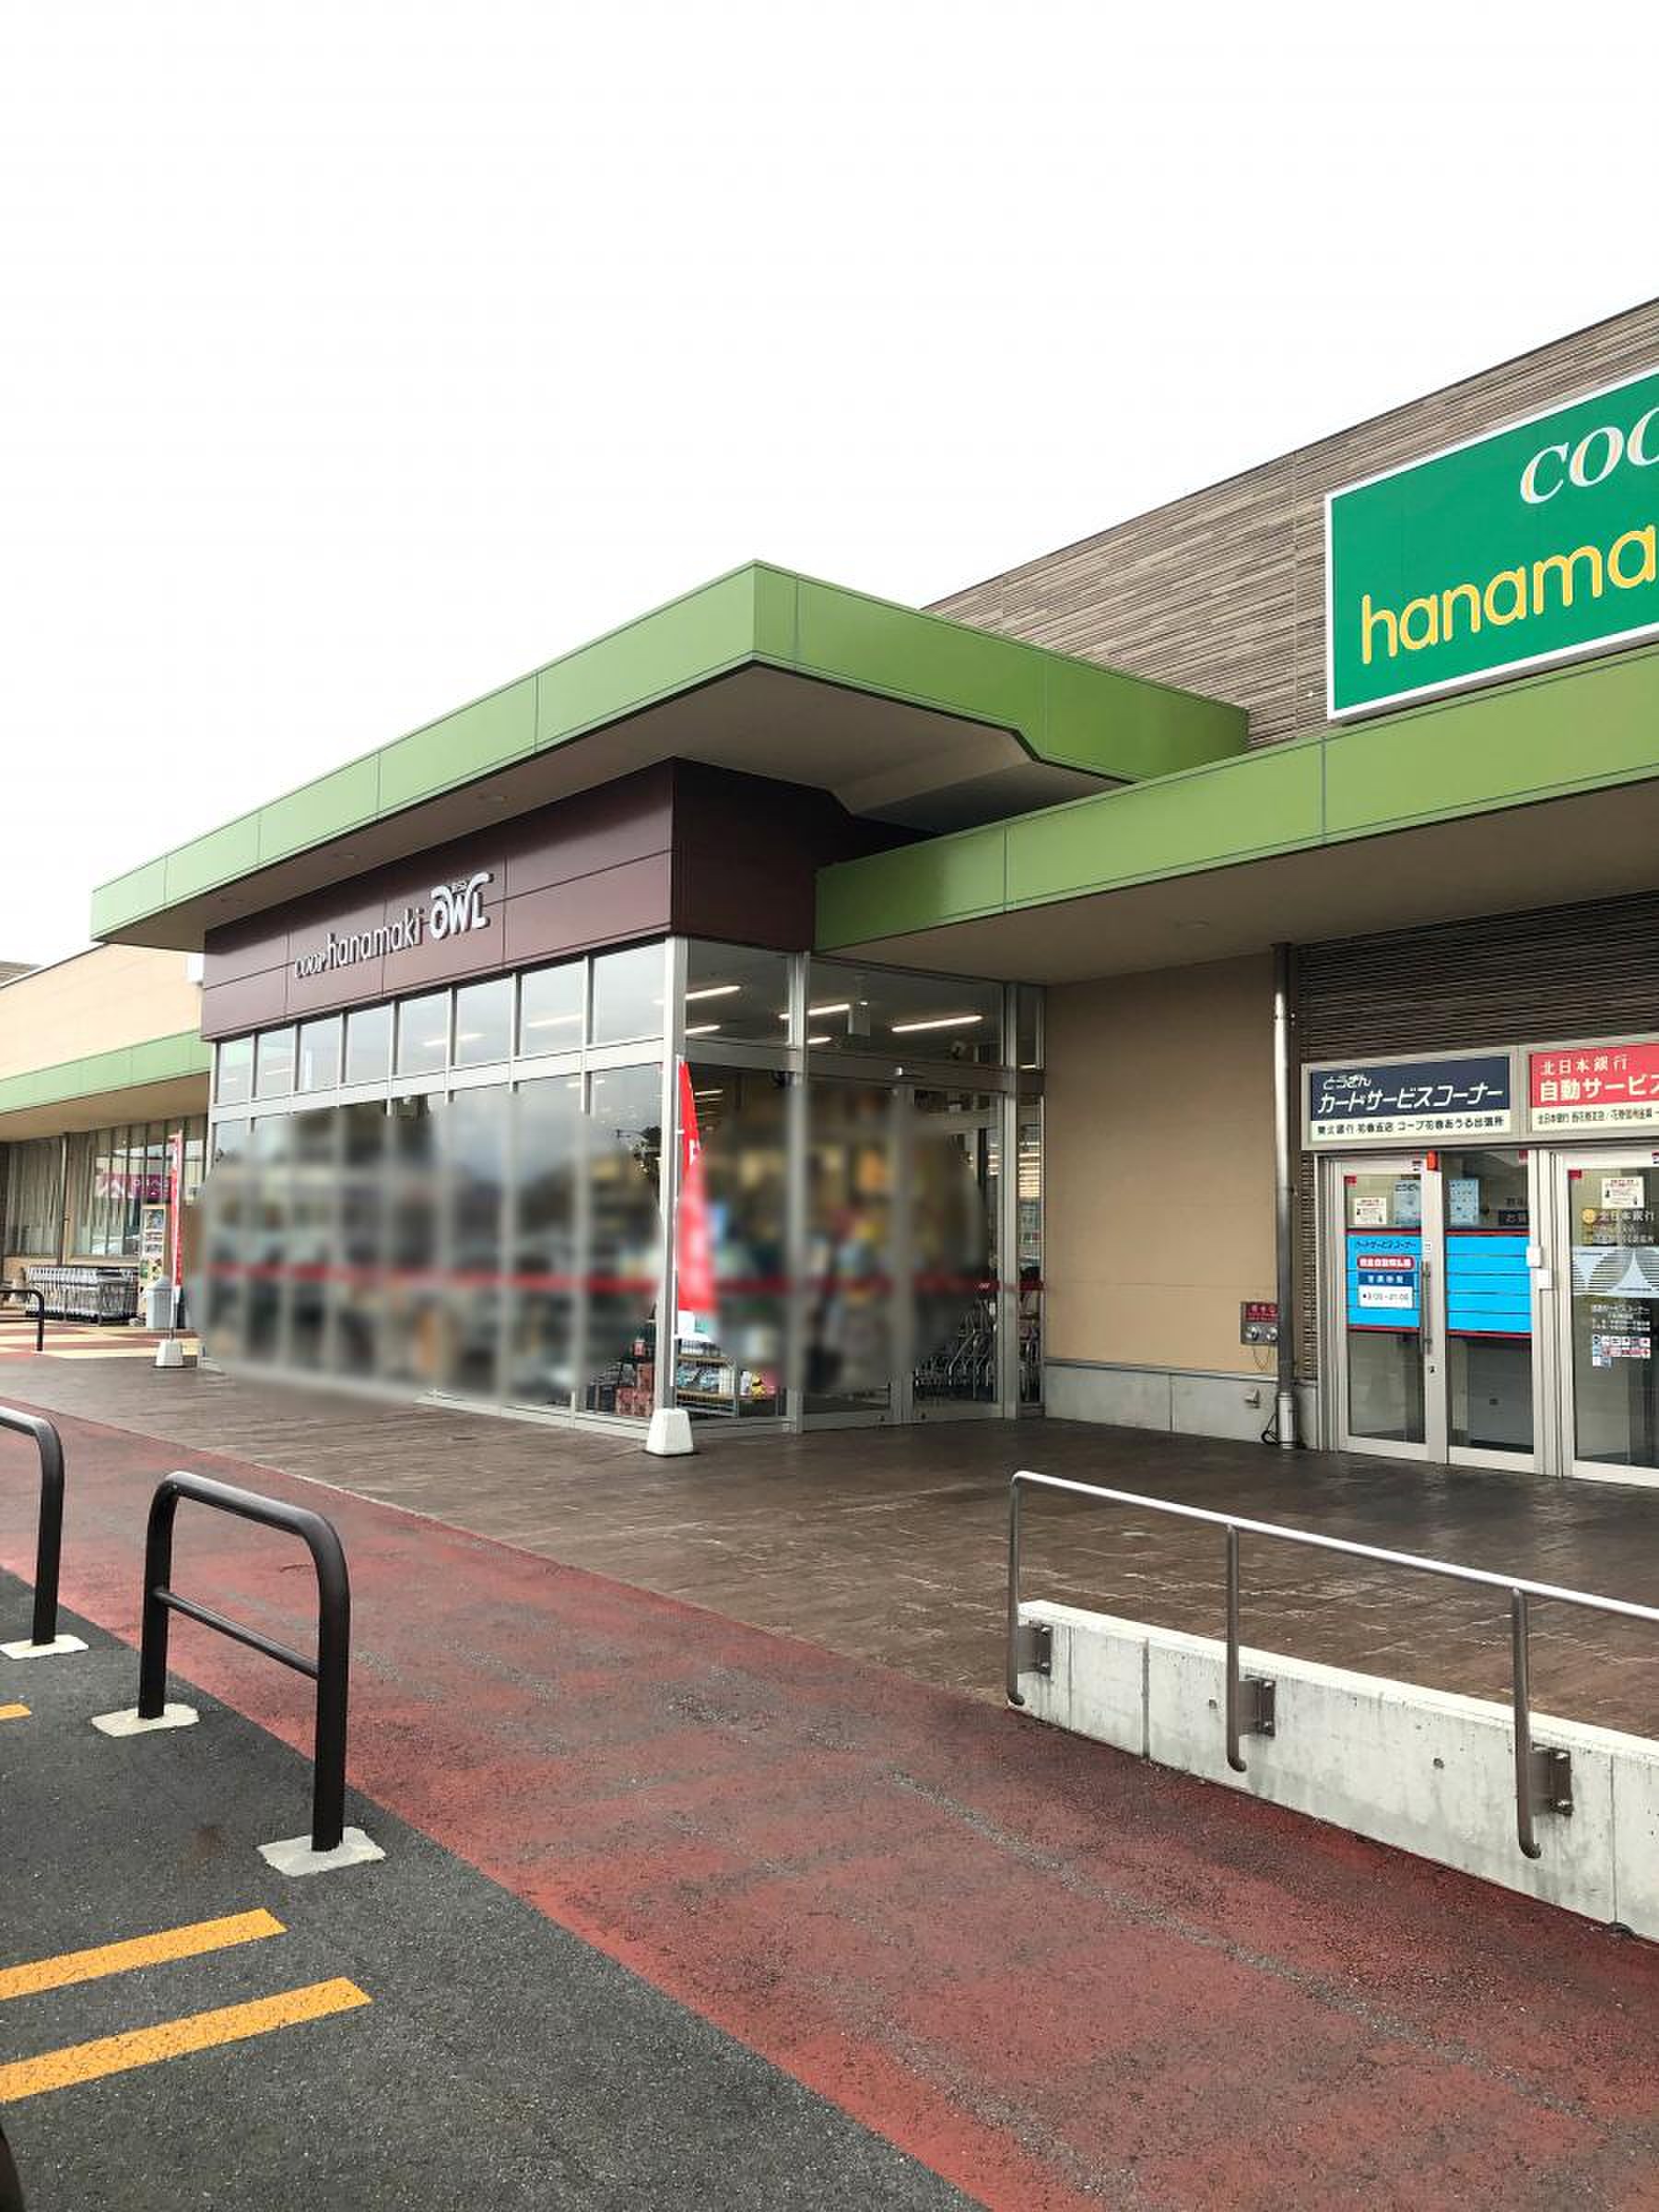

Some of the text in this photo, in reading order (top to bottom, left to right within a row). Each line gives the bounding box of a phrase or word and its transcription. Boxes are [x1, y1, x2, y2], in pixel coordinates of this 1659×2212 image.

[1361, 524, 1657, 665] hanama
[327, 908, 421, 971] hanamaki
[429, 871, 492, 939] OWL
[1540, 1054, 1628, 1077] 北日本銀行
[1318, 1082, 1504, 1114] カードサービスコーナー
[1323, 1074, 1371, 1090] とうぎん
